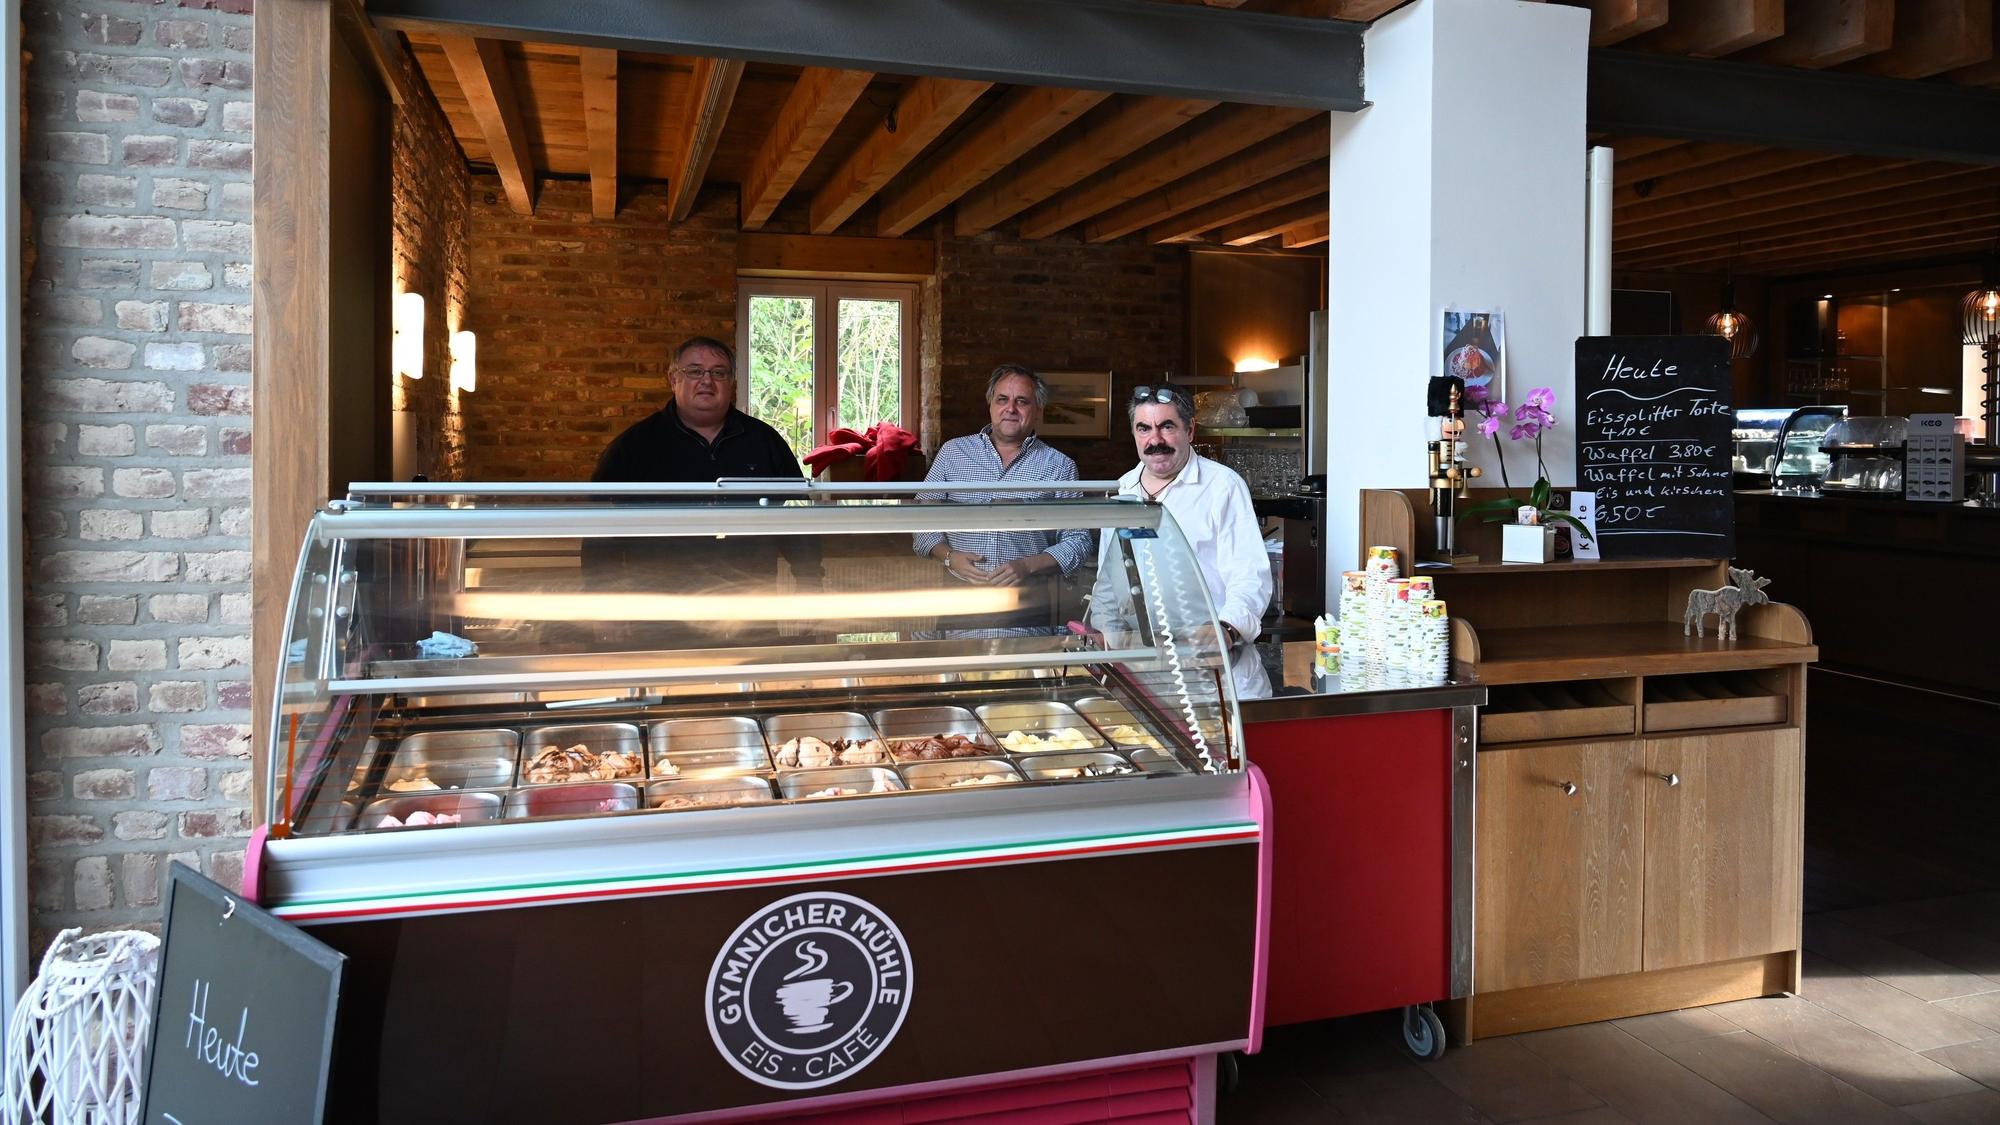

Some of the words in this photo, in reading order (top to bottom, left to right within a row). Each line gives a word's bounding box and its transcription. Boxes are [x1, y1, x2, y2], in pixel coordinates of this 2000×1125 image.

[1602, 354, 1678, 381] Heute
[1587, 405, 1682, 426] Eissplitter
[1689, 398, 1731, 416] Torte
[1583, 446, 1655, 463] Waffel
[1668, 445, 1716, 458] 3,80€
[1584, 468, 1656, 482] Waffel
[1660, 465, 1683, 479] mit
[1596, 487, 1618, 499] Eis
[1626, 486, 1655, 497] und
[1578, 505, 1590, 551] Kate
[718, 903, 847, 1025] GYMNICHER
[850, 914, 901, 1005] MÜHLE
[186, 979, 259, 1086] Heute
[740, 1041, 783, 1075] EIS
